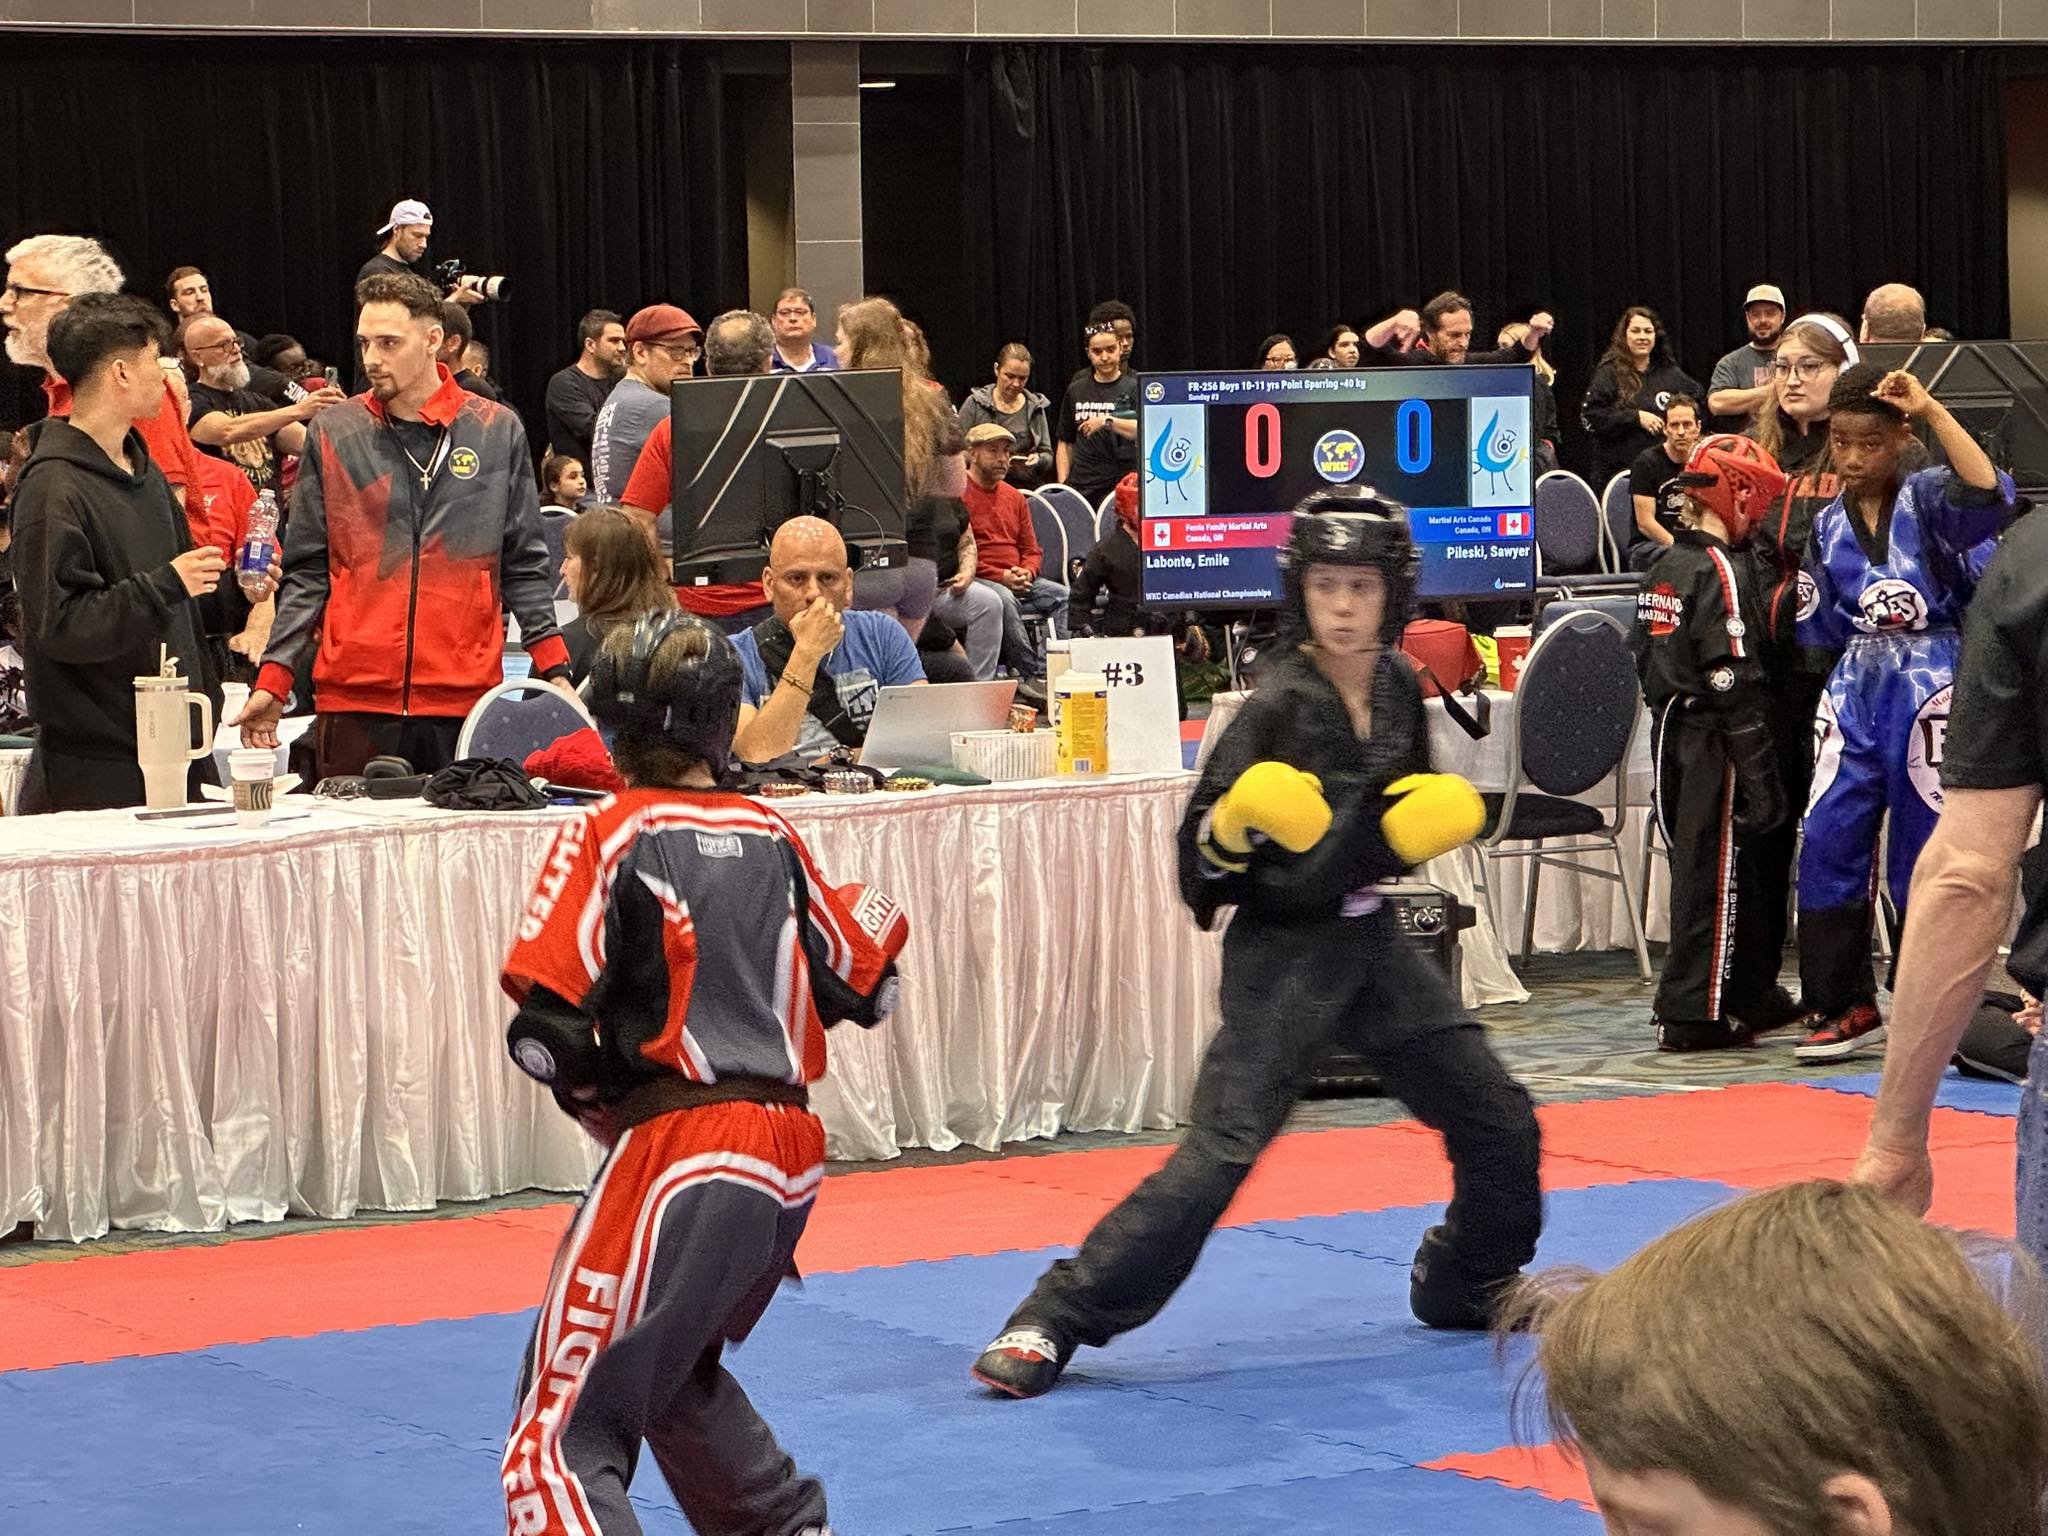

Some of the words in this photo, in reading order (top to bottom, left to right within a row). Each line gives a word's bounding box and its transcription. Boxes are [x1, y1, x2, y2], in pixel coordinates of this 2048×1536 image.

[1188, 381, 1218, 392] FR-256
[1219, 381, 1239, 393] Boys
[1241, 380, 1265, 391] 10-11
[1266, 381, 1280, 393] yrs
[1281, 379, 1303, 390] Point
[1304, 378, 1339, 391] Sparring
[1340, 378, 1354, 389] -40
[1355, 378, 1366, 390] kg
[1188, 393, 1210, 402] Sunday
[1245, 402, 1282, 479] 0
[1395, 398, 1433, 475] 0
[1206, 522, 1227, 533] Family
[1228, 522, 1252, 531] Martial
[1253, 521, 1268, 530] Arts
[1429, 516, 1452, 525] Martial
[1453, 516, 1467, 524] Arts
[1468, 515, 1492, 524] Canada
[1454, 526, 1480, 535] Canada,
[1481, 525, 1492, 533] ON
[1185, 534, 1212, 543] Canada,
[1213, 533, 1224, 542] ON
[1446, 545, 1488, 560] Pileski,
[1490, 545, 1531, 560] Sawyer
[1146, 555, 1196, 570] Labonte,
[1198, 553, 1230, 567] Emile
[1145, 592, 1162, 601] WKC
[1163, 591, 1193, 600] Canadian
[1194, 590, 1221, 599] National
[1222, 588, 1272, 600] Championships
[1101, 662, 1145, 688] #3
